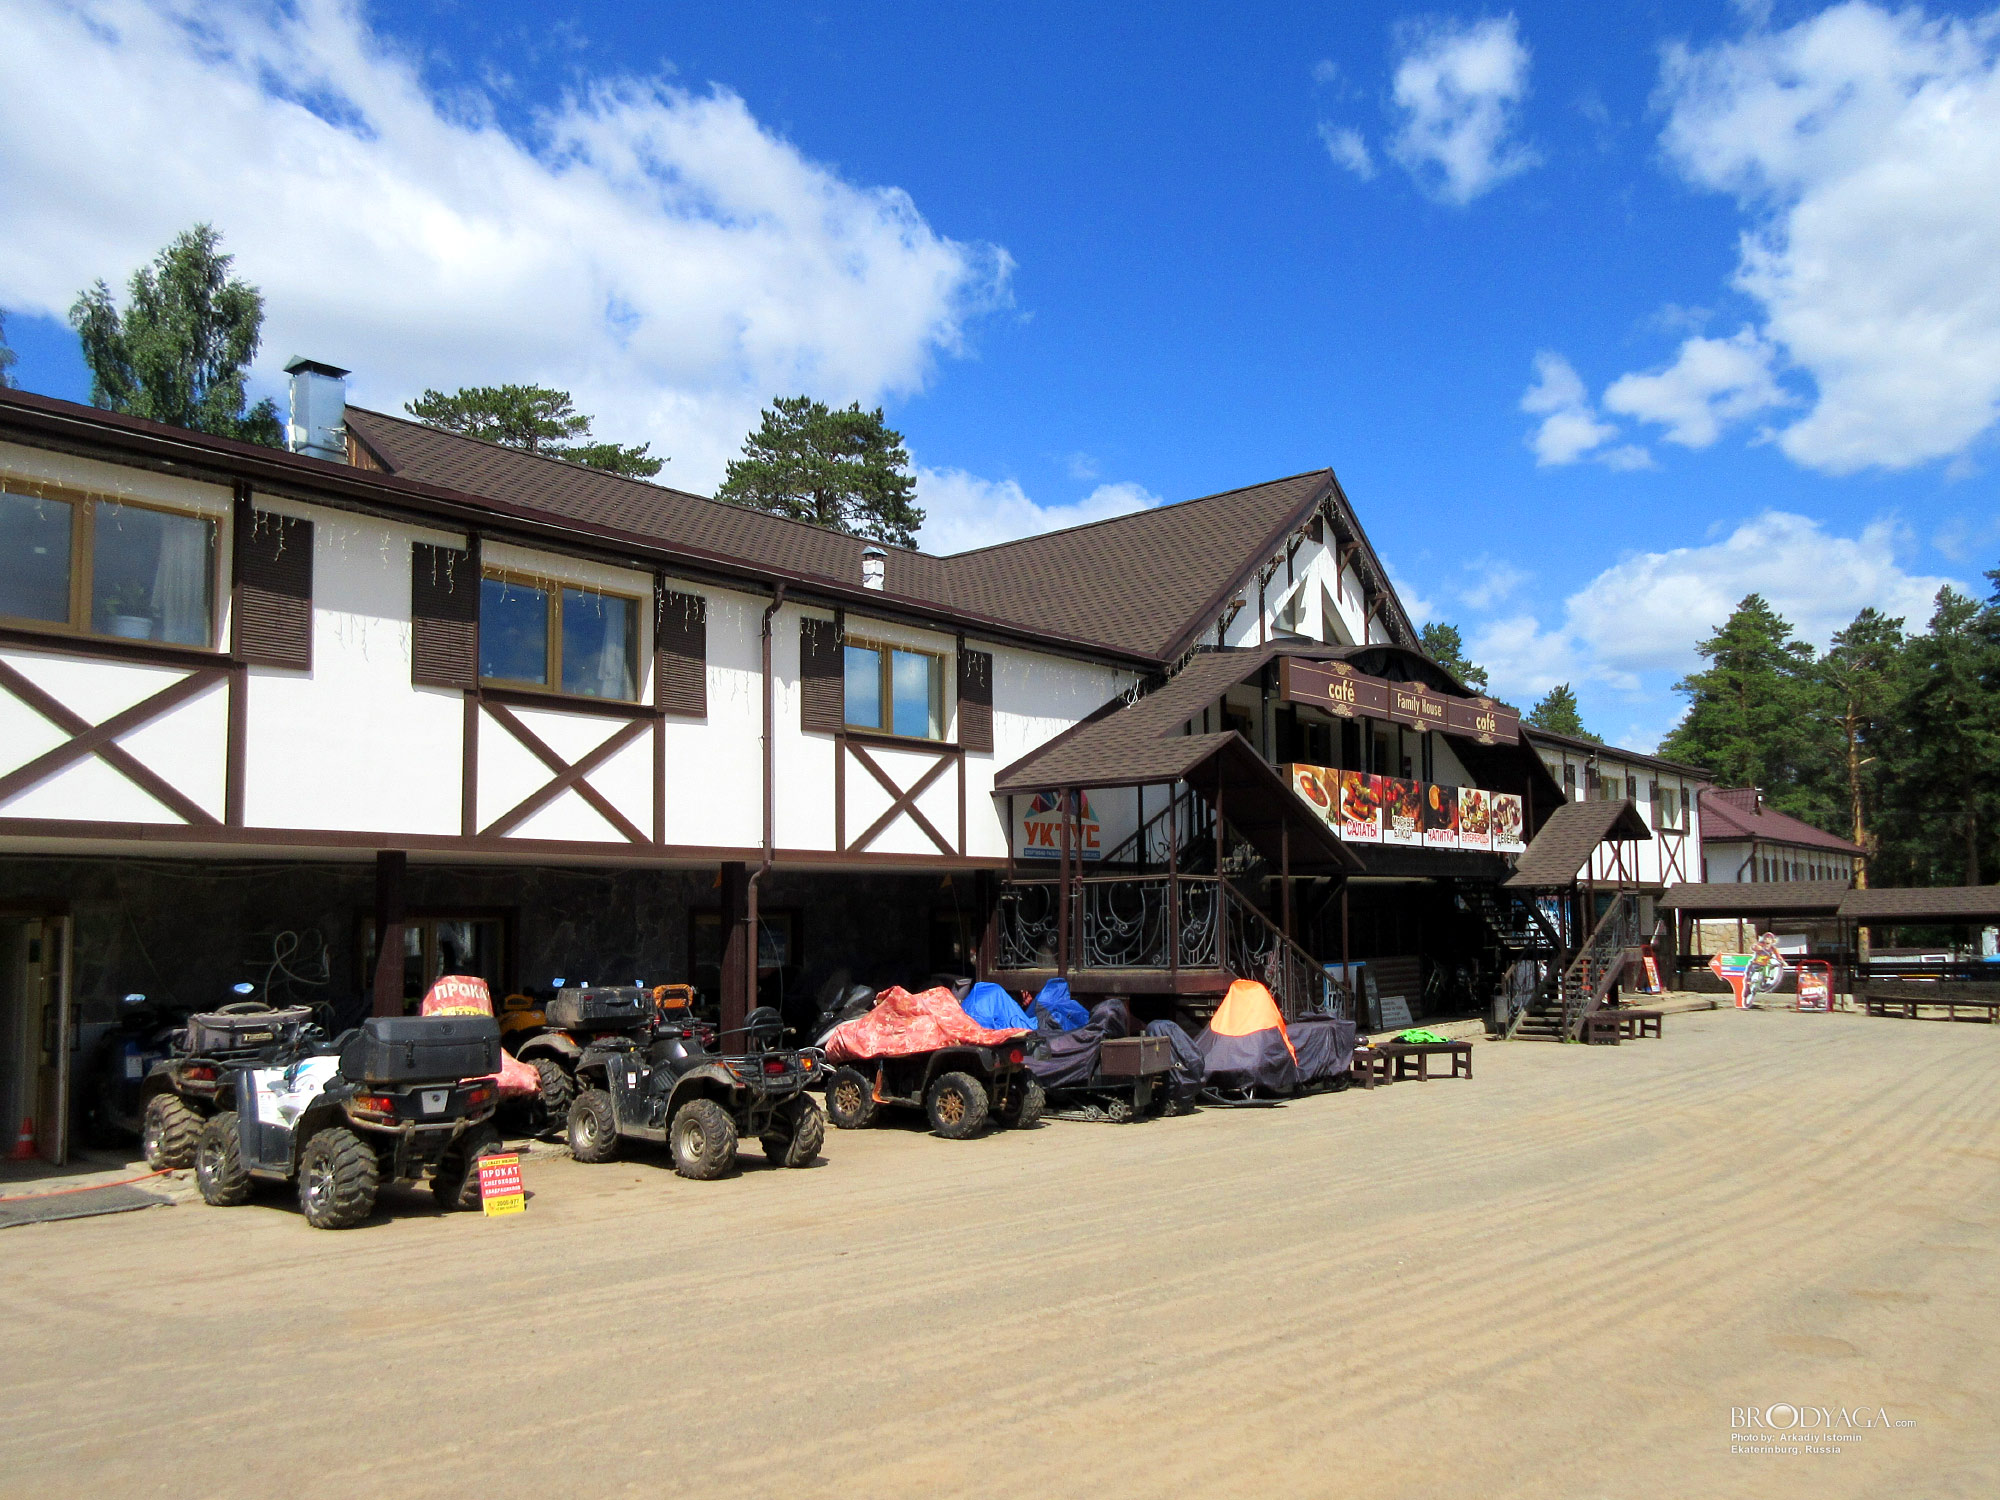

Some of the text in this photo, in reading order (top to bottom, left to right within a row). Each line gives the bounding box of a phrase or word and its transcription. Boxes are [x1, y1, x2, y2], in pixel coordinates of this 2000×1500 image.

[1328, 679, 1355, 703] café
[1397, 692, 1442, 717] Family House
[1475, 712, 1496, 732] café
[1346, 819, 1377, 838] САЛАТЫ
[1427, 828, 1454, 843] НАПИТКИ
[1497, 832, 1520, 846] ДЕСЕРТЫ
[482, 1166, 518, 1180] ПРОКАТ
[484, 1177, 520, 1187] СНЕГОХОДОВ
